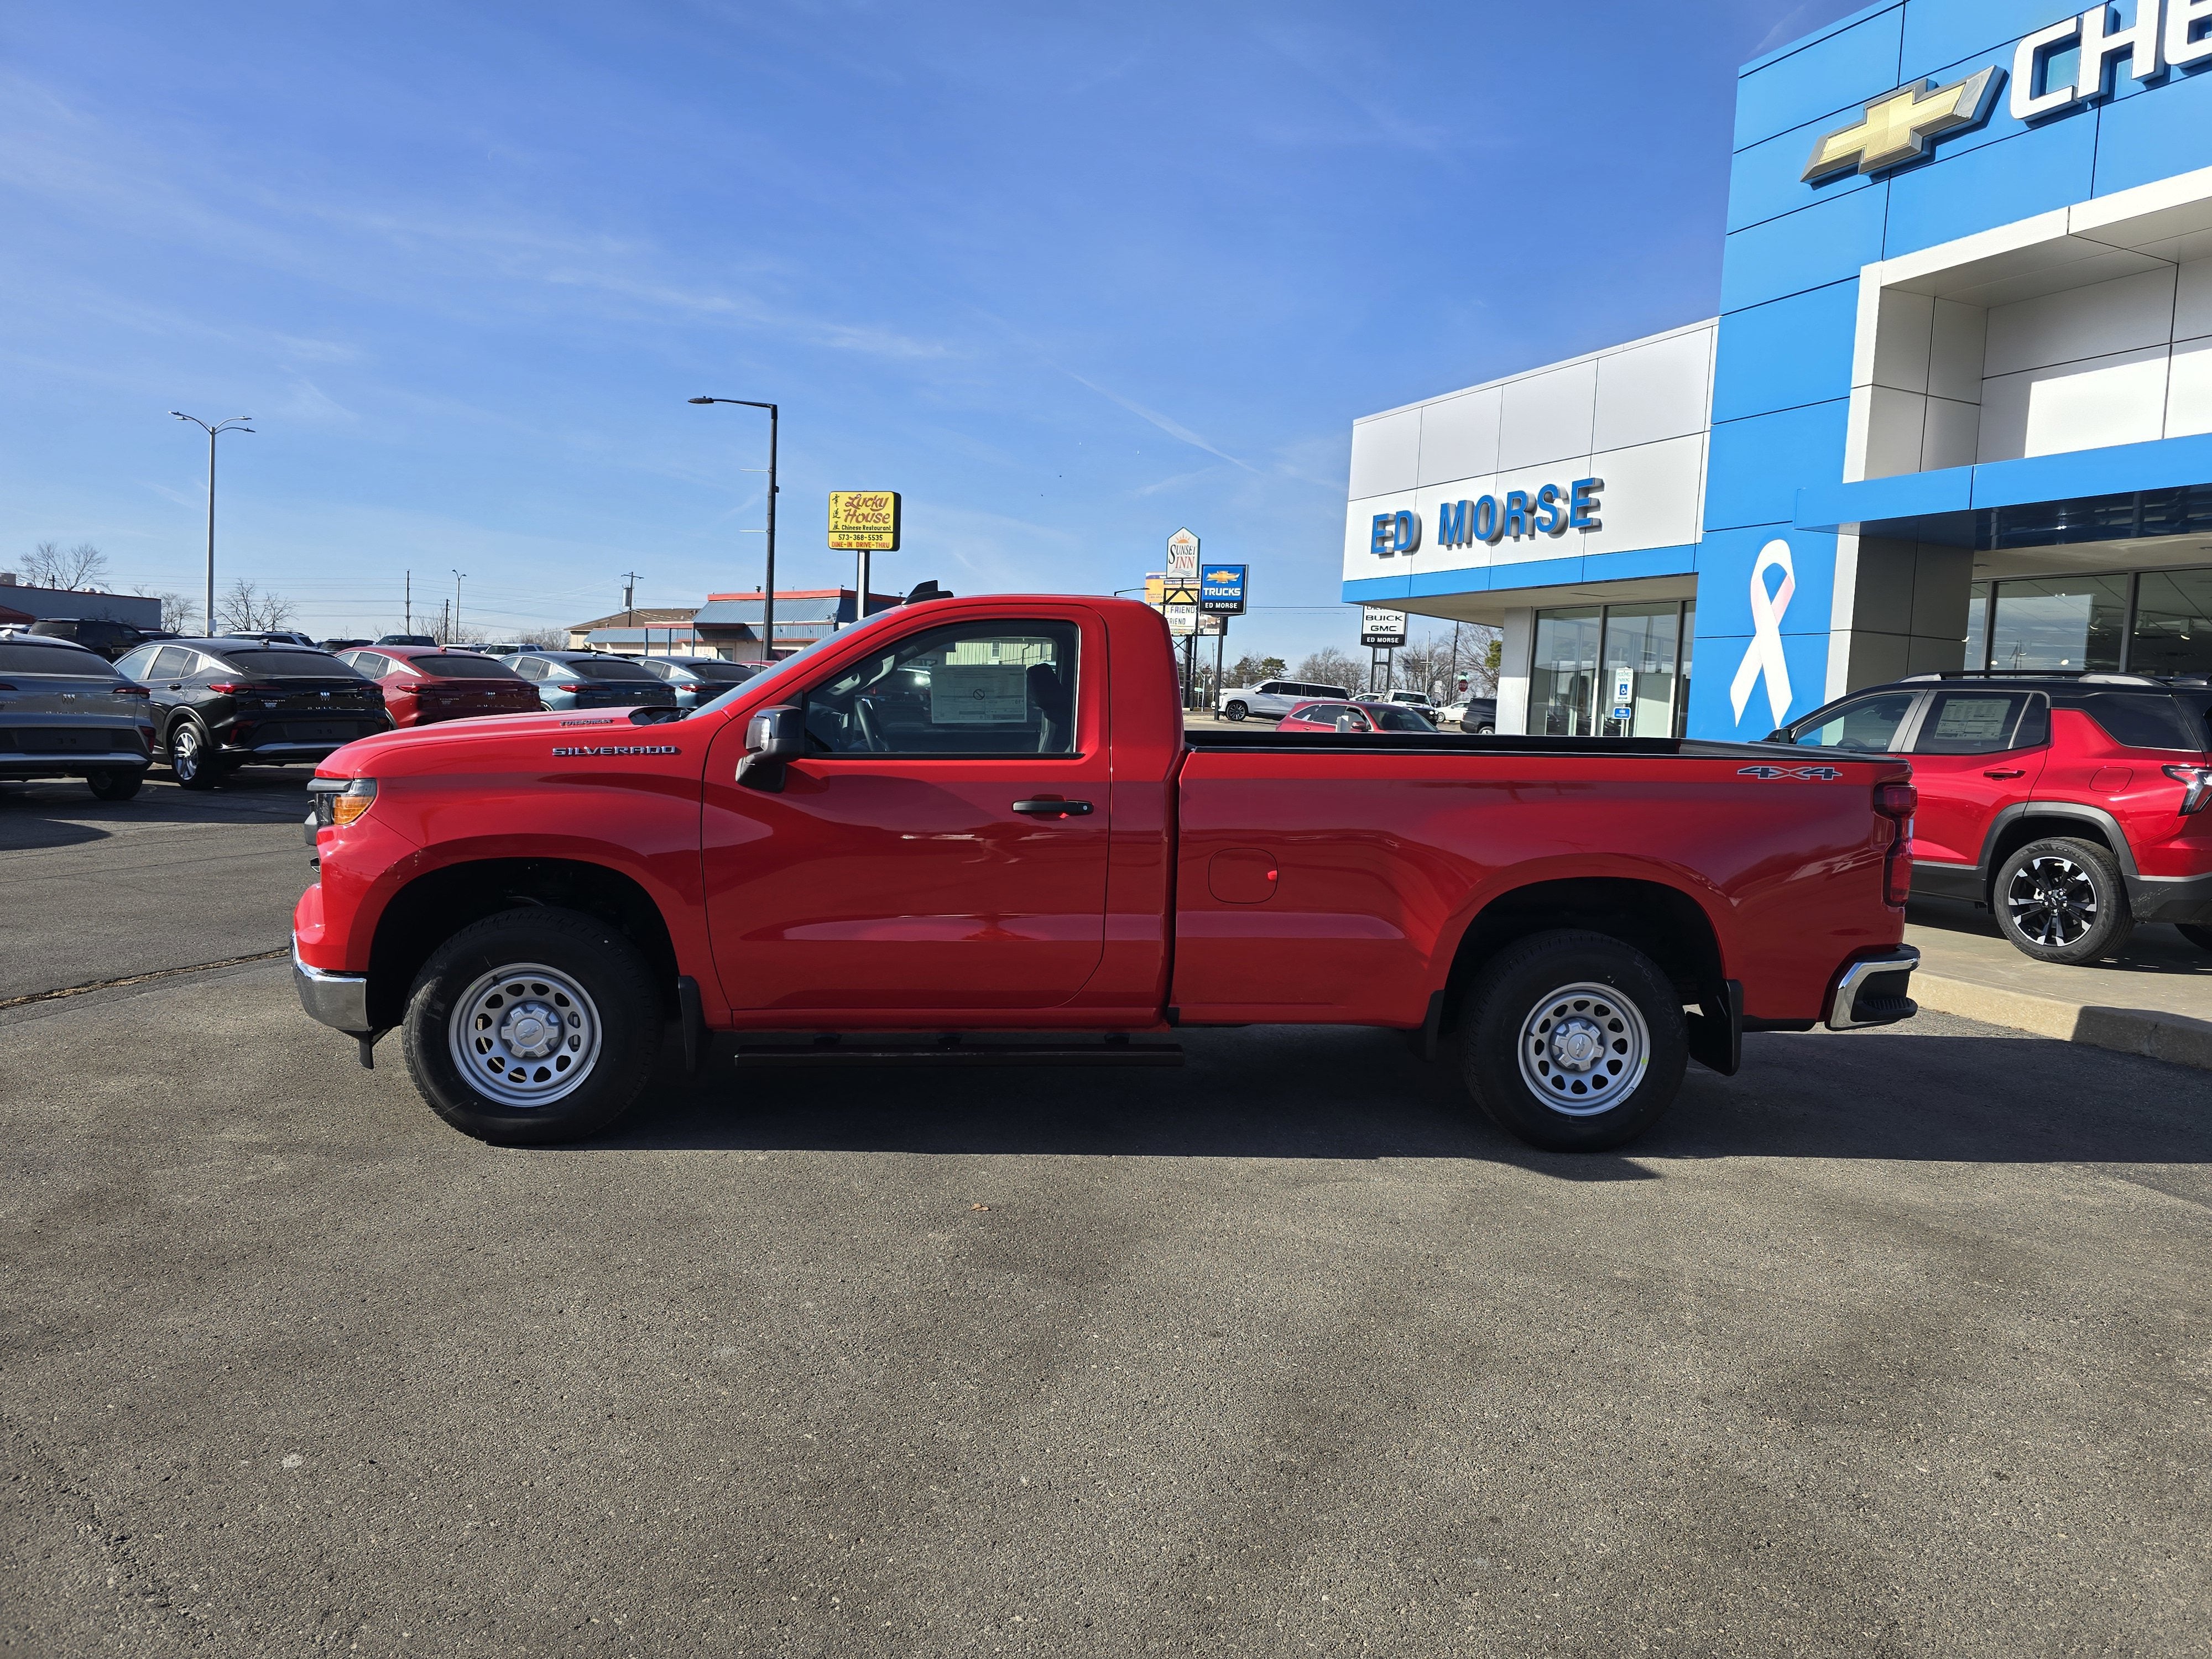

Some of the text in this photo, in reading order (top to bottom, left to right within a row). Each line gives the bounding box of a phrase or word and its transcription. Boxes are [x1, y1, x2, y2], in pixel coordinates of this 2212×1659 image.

[845, 493, 890, 512] Lucky
[843, 508, 890, 524] House
[1371, 477, 1602, 555] ED MORSE
[1175, 556, 1195, 569] INN
[1203, 587, 1241, 596] TRUCKS
[552, 745, 676, 756] SILVERADO
